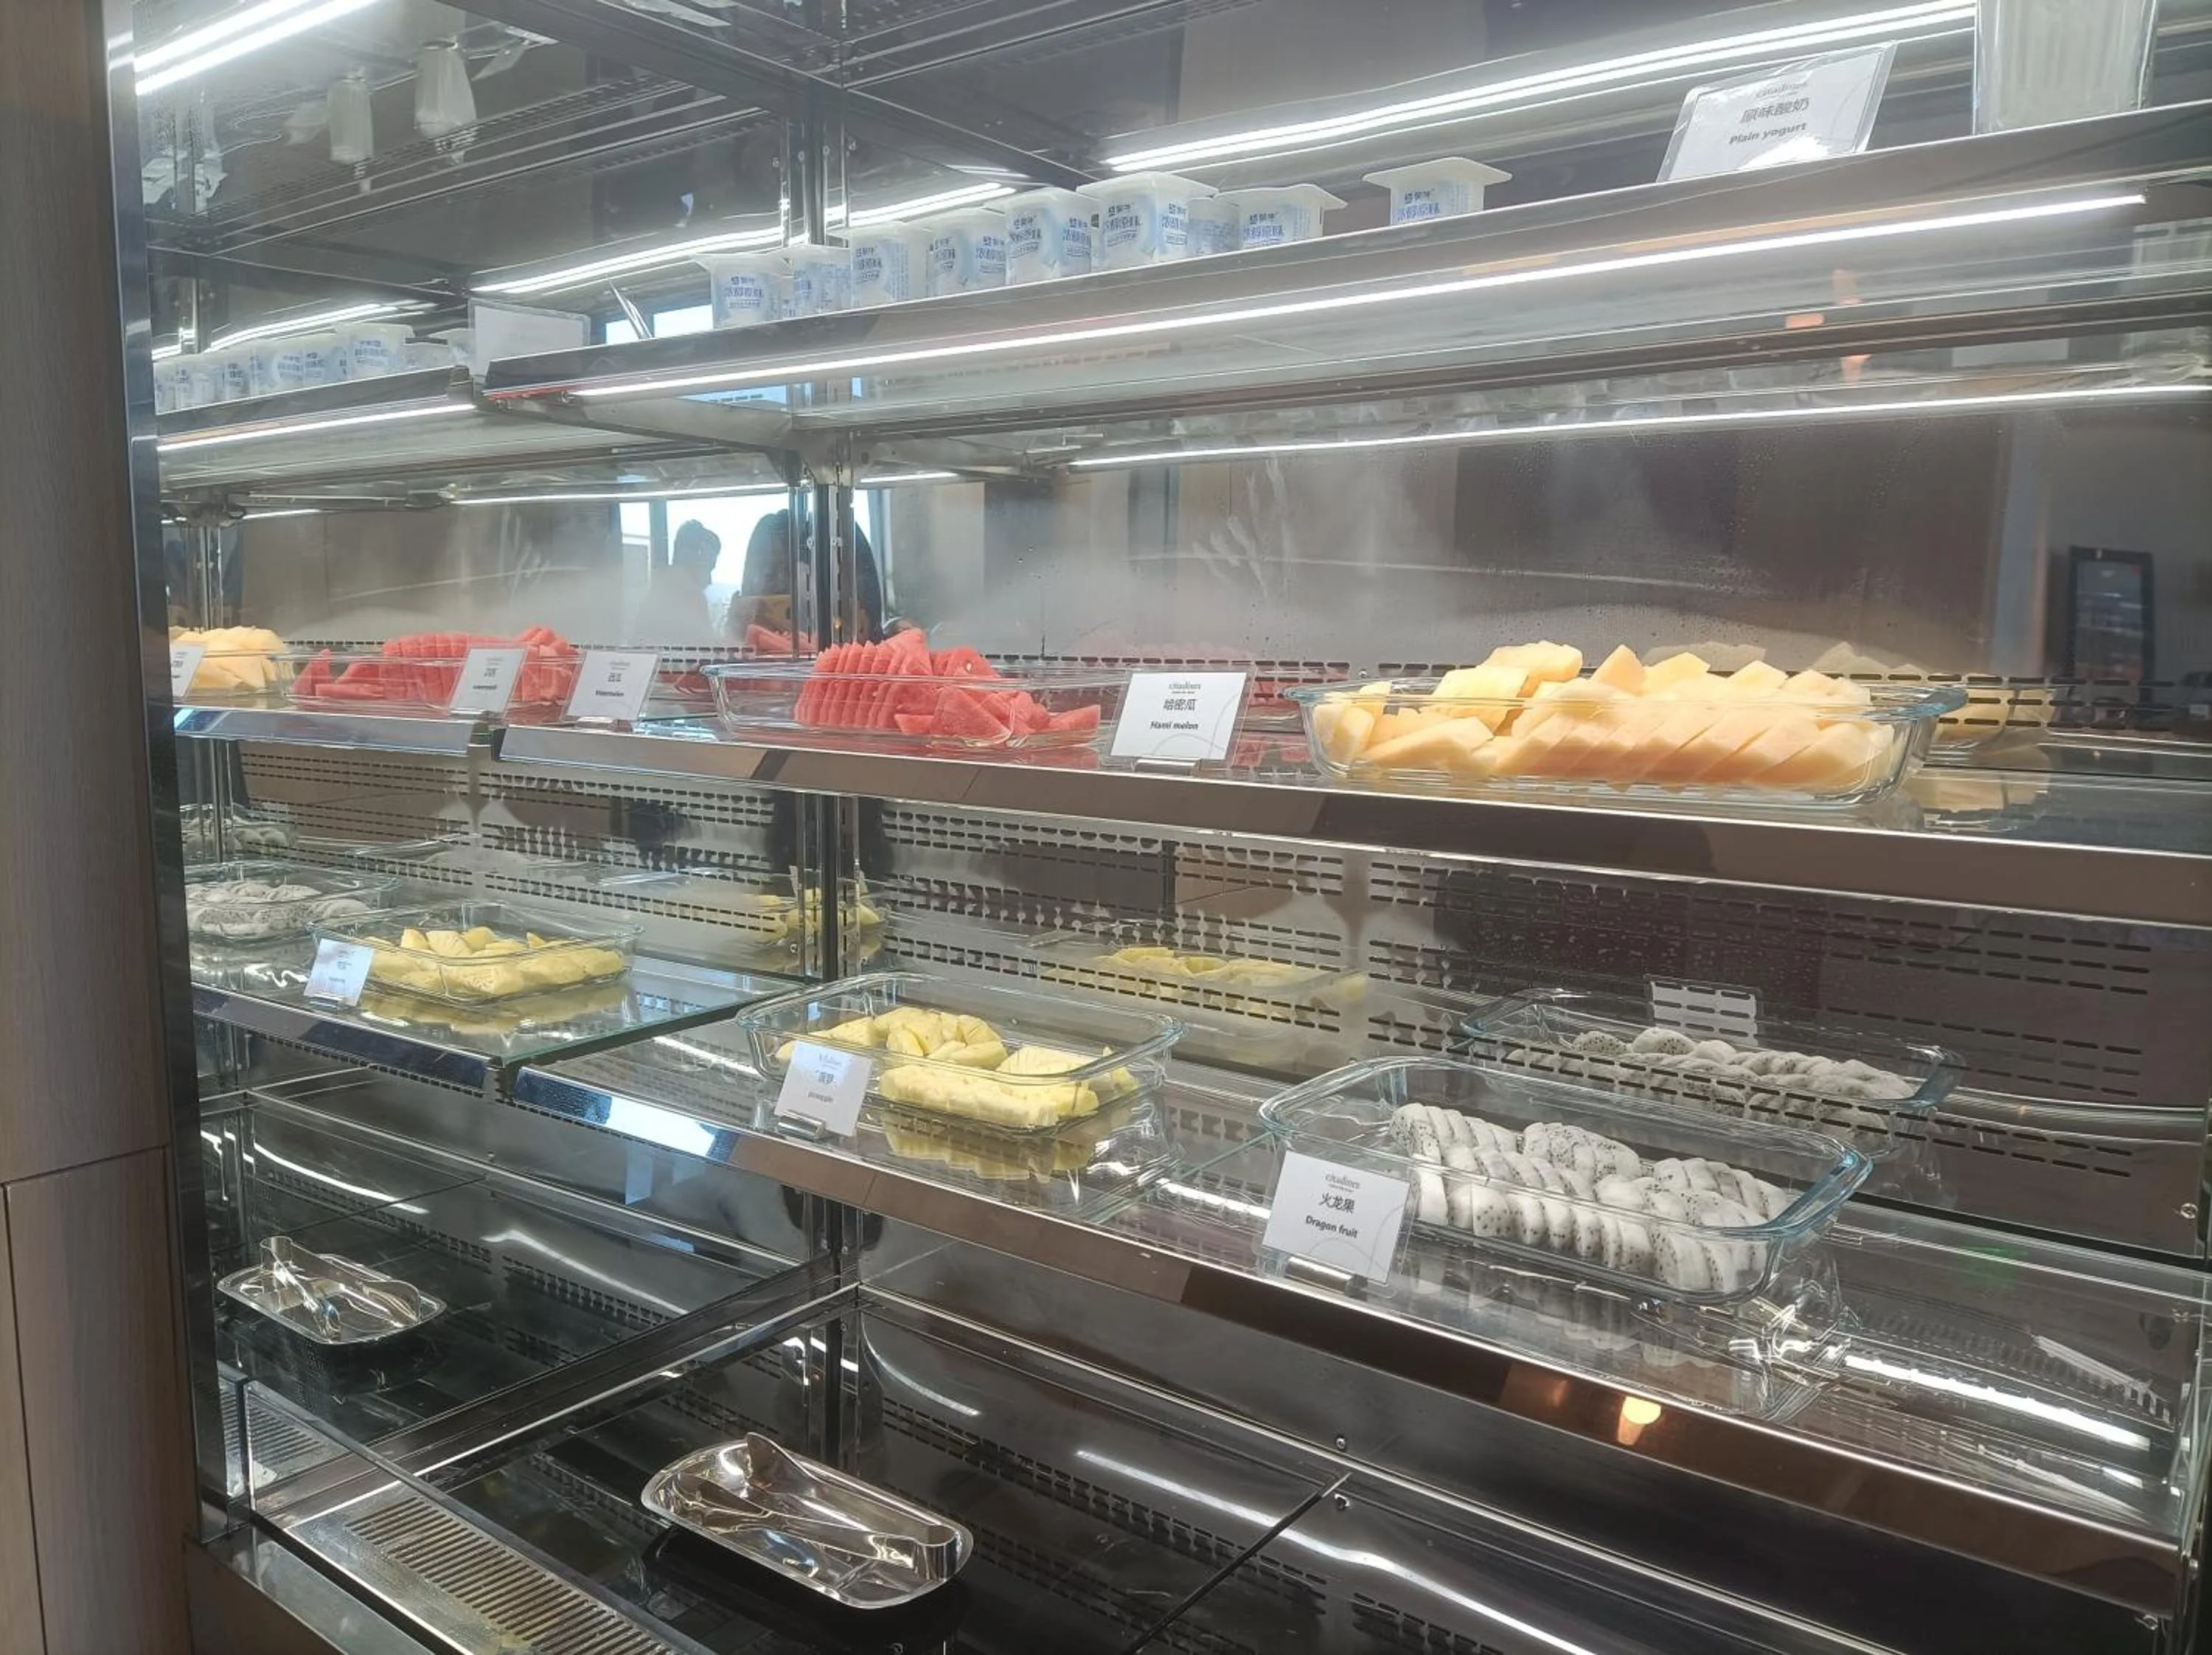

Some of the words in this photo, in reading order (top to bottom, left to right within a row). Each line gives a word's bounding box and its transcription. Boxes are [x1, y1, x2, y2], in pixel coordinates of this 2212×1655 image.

[1741, 97, 1809, 123] 原味酸奶
[1729, 131, 1759, 144] Plain
[1761, 122, 1807, 140] yogurt
[1163, 698, 1196, 710] 哈密瓜
[1150, 721, 1171, 729] Hami
[1172, 721, 1198, 729] melon
[1318, 1193, 1354, 1212] 火龙果
[1306, 1215, 1337, 1232] Dragon
[1338, 1224, 1357, 1238] fruit
